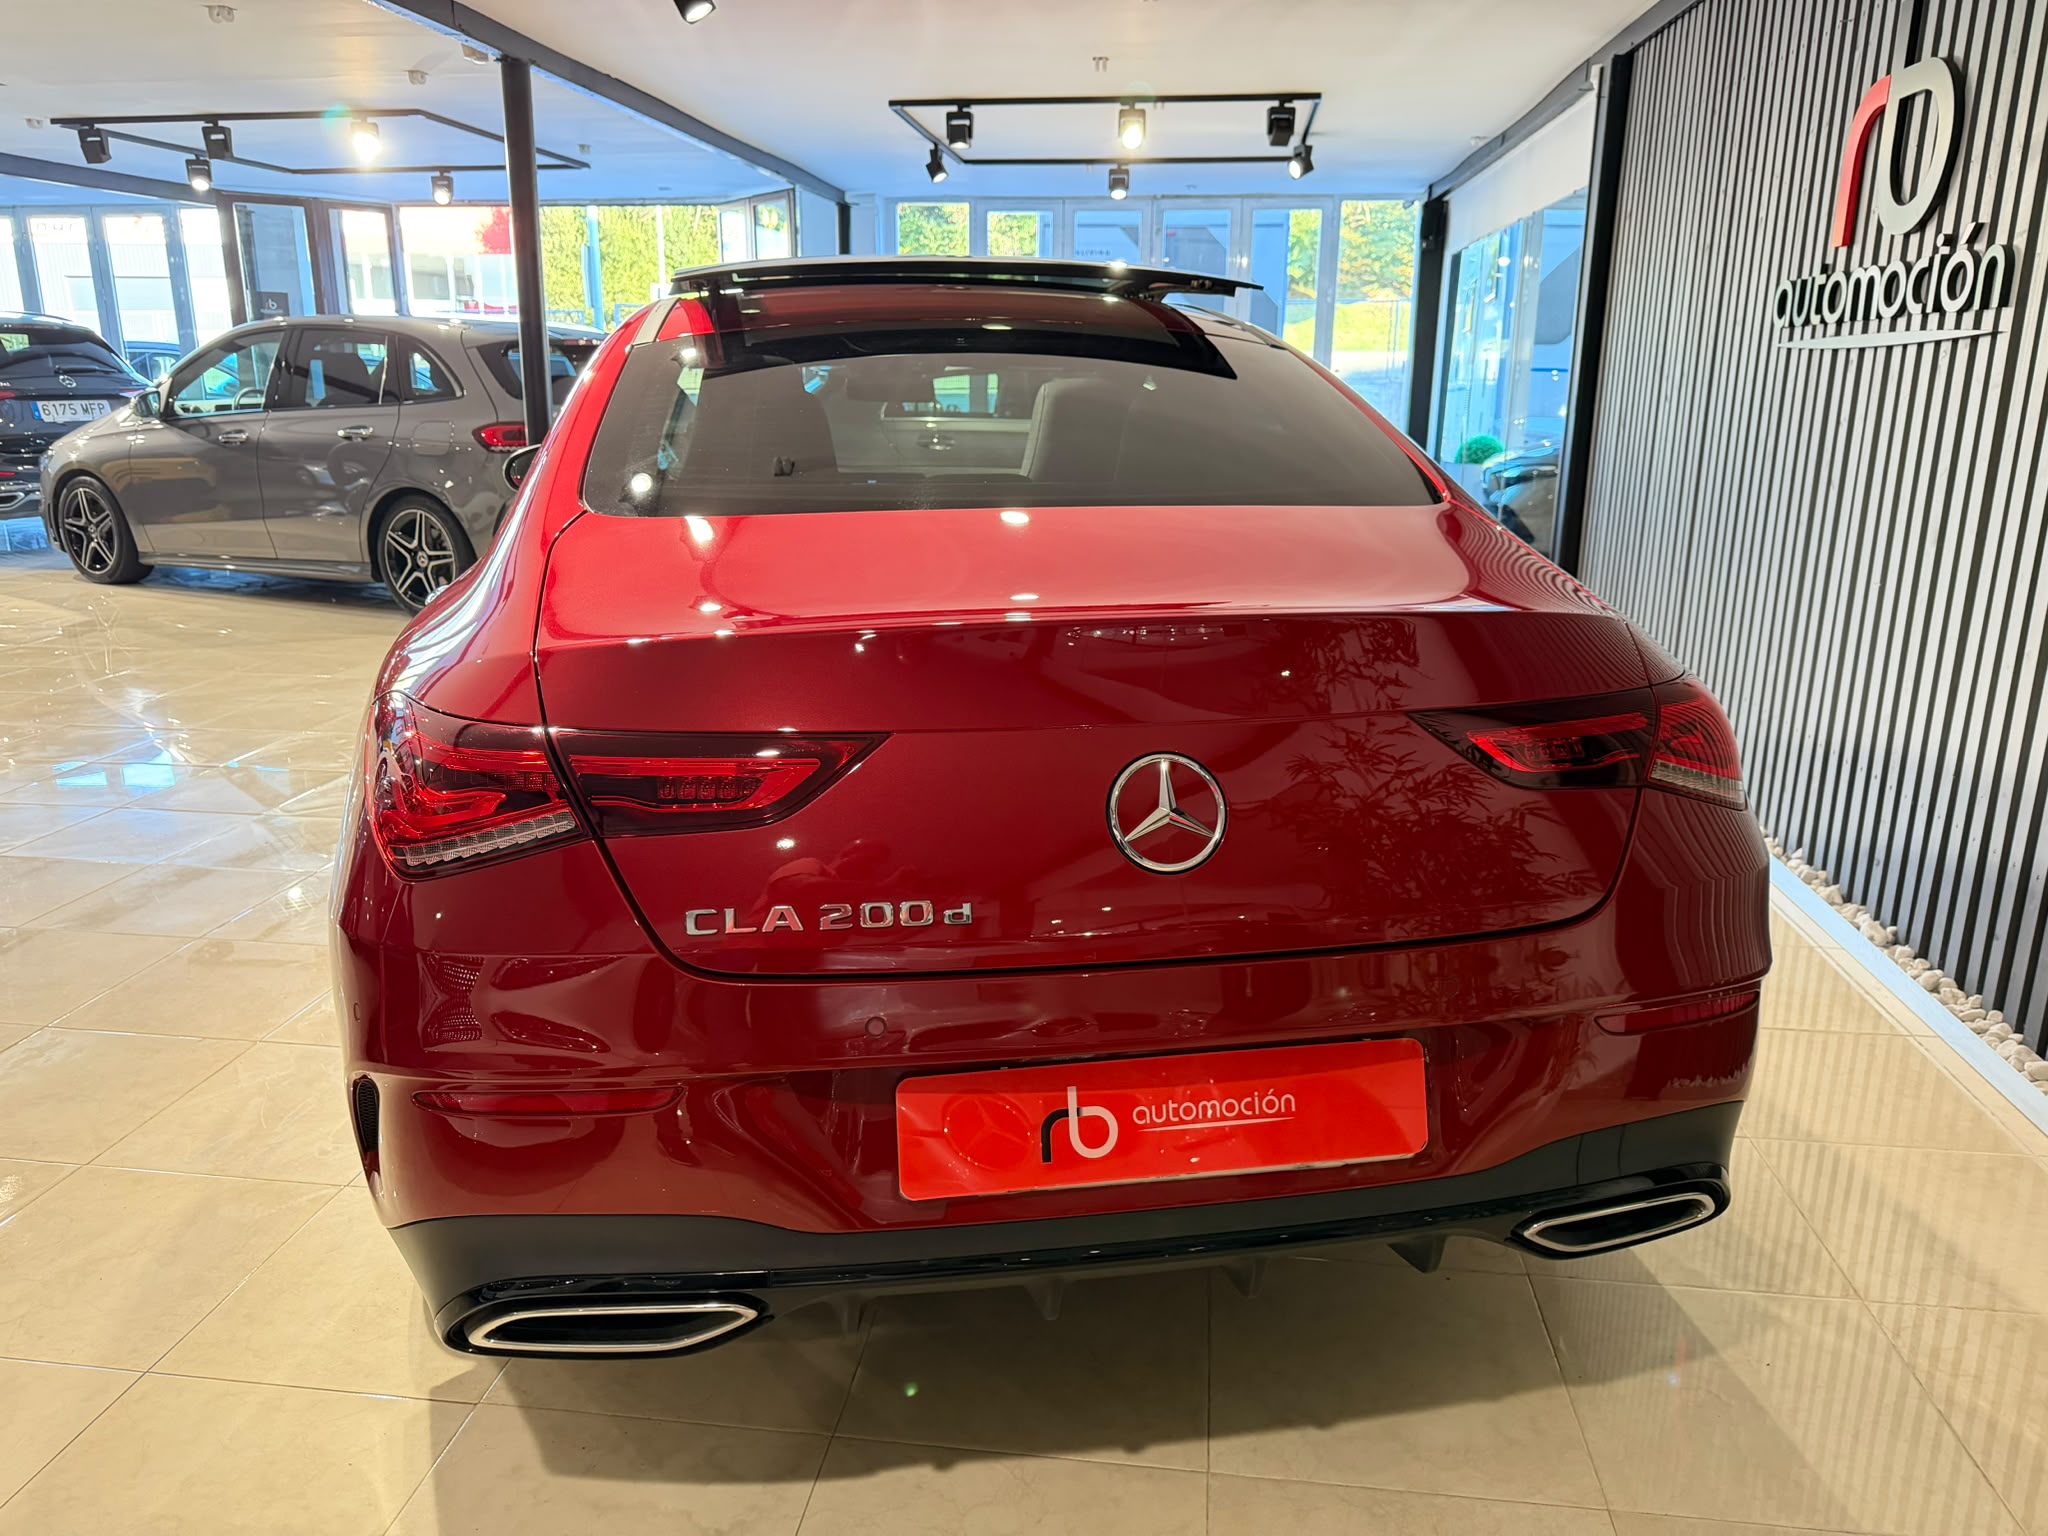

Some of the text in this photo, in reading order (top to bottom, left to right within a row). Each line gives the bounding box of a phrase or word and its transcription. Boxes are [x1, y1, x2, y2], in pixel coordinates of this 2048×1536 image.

[1774, 222, 2014, 328] automoción
[41, 402, 105, 417] 6175 MFP
[685, 905, 804, 936] CLA
[1131, 1088, 1297, 1118] automoción
[1040, 1086, 1119, 1163] rb
